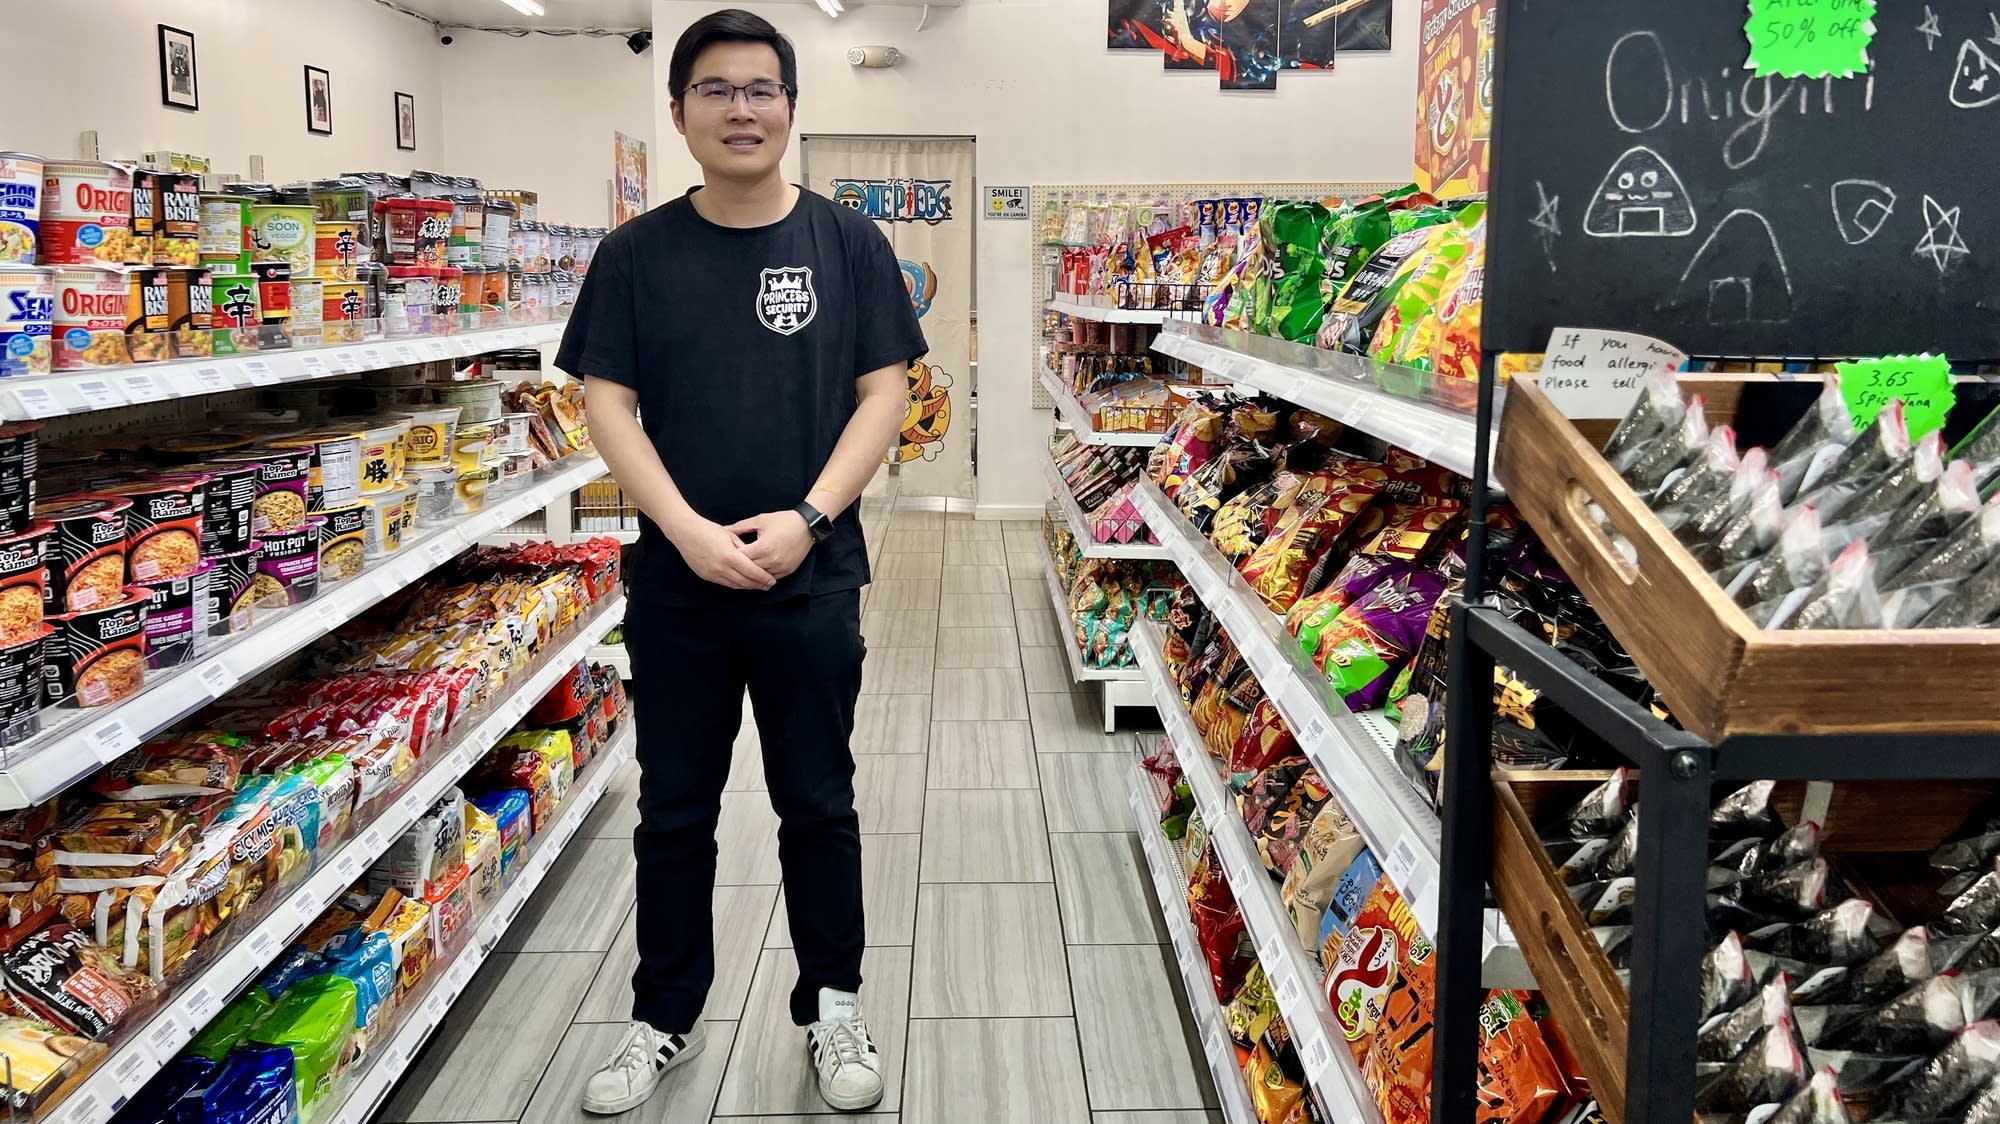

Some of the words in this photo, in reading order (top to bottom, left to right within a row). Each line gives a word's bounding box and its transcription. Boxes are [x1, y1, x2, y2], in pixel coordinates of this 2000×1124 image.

[1763, 17, 1816, 48] 50%
[1828, 18, 1861, 39] off
[894, 183, 952, 218] PIECE
[267, 222, 300, 232] SOON
[335, 228, 356, 268] 辛
[763, 289, 810, 305] PRINCESS
[765, 303, 808, 316] SECURITY
[1562, 334, 1581, 349] If
[1600, 338, 1628, 351] you
[1646, 343, 1680, 358] have
[1552, 355, 1587, 369] food
[1544, 376, 1589, 389] Please
[1612, 378, 1636, 389] tell
[1867, 370, 1914, 387] 3.65
[1856, 390, 1889, 407] Spic
[263, 464, 283, 473] Top
[263, 470, 297, 480] Ramen
[150, 500, 175, 510] Top
[152, 505, 192, 518] Ramen
[334, 516, 351, 525] Top
[335, 520, 361, 532] Ramen
[93, 523, 114, 534] Top
[93, 530, 126, 543] Ramen
[264, 541, 287, 553] HOT
[286, 537, 306, 549] POT
[270, 548, 301, 556] FUSIONS
[1373, 577, 1411, 613] Doritos
[99, 617, 124, 628] Top
[101, 621, 140, 638] Ramen
[248, 838, 274, 863] Ramen
[1347, 936, 1361, 951] Potato
